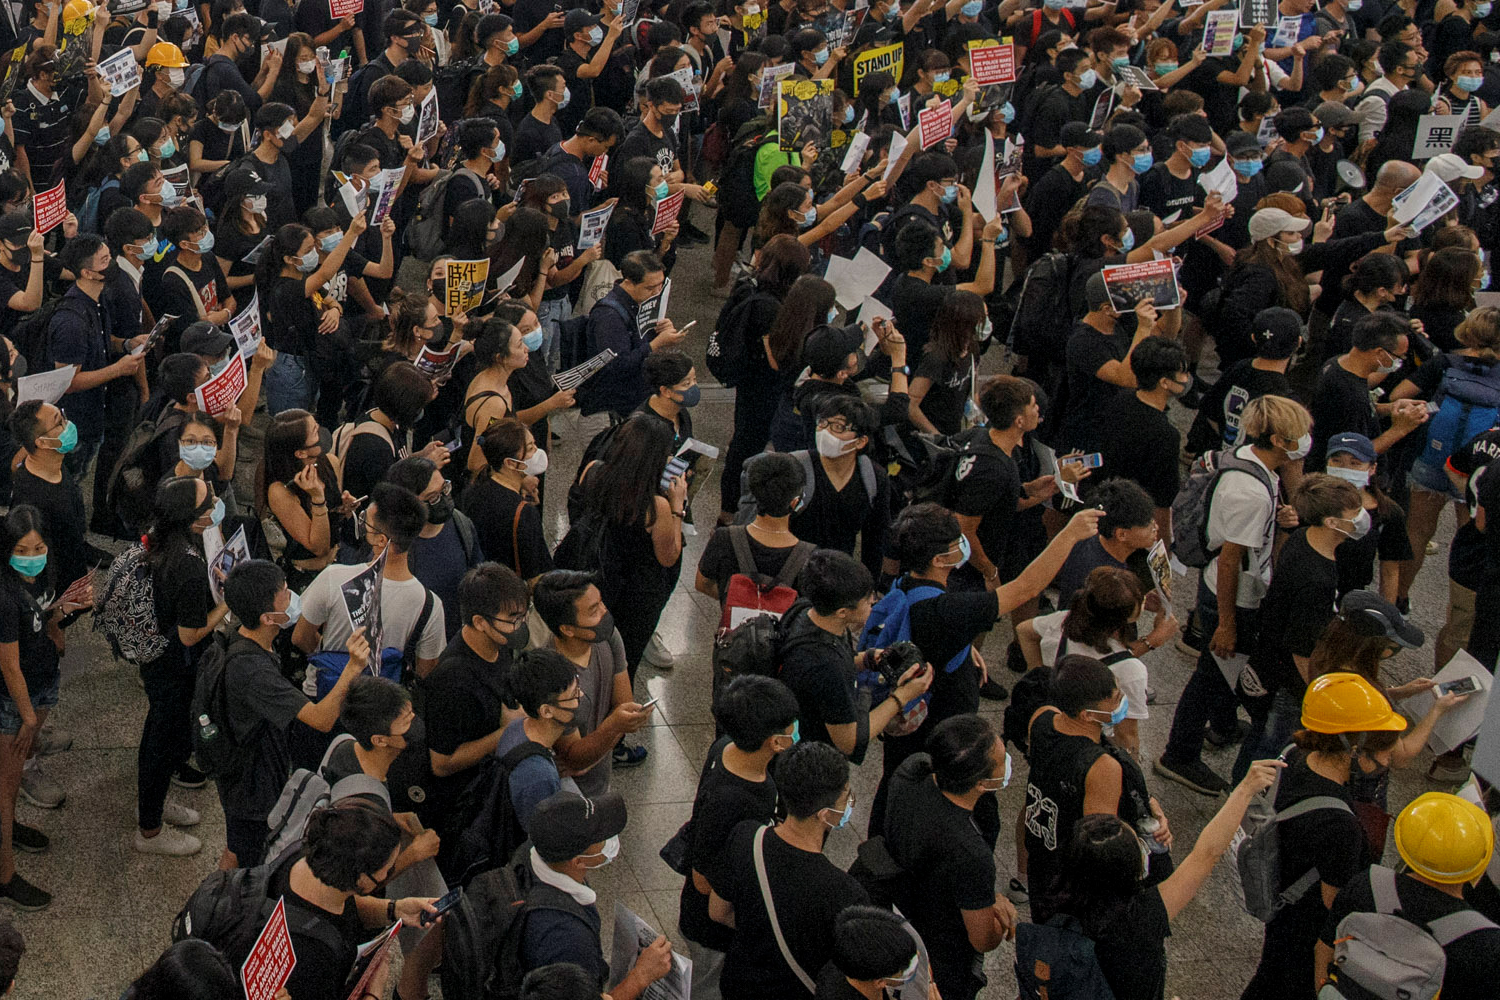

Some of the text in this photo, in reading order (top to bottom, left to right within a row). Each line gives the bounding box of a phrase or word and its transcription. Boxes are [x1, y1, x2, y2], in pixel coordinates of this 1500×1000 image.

[857, 47, 902, 75] STAND UP
[1426, 128, 1453, 148] 黑
[45, 200, 59, 211] POLICE
[46, 207, 59, 216] ANGRY
[39, 211, 60, 225] SELECTIVE
[448, 264, 476, 290] 時代
[641, 300, 657, 312] THEY
[216, 381, 232, 397] POLICE
[232, 368, 242, 382] MAKE
[218, 385, 234, 401] ANGRY
[352, 606, 366, 618] THEY
[249, 924, 285, 996] HK POLICE MAKE
[260, 935, 287, 990] ANGRY WITH
[279, 944, 289, 966] LAW
